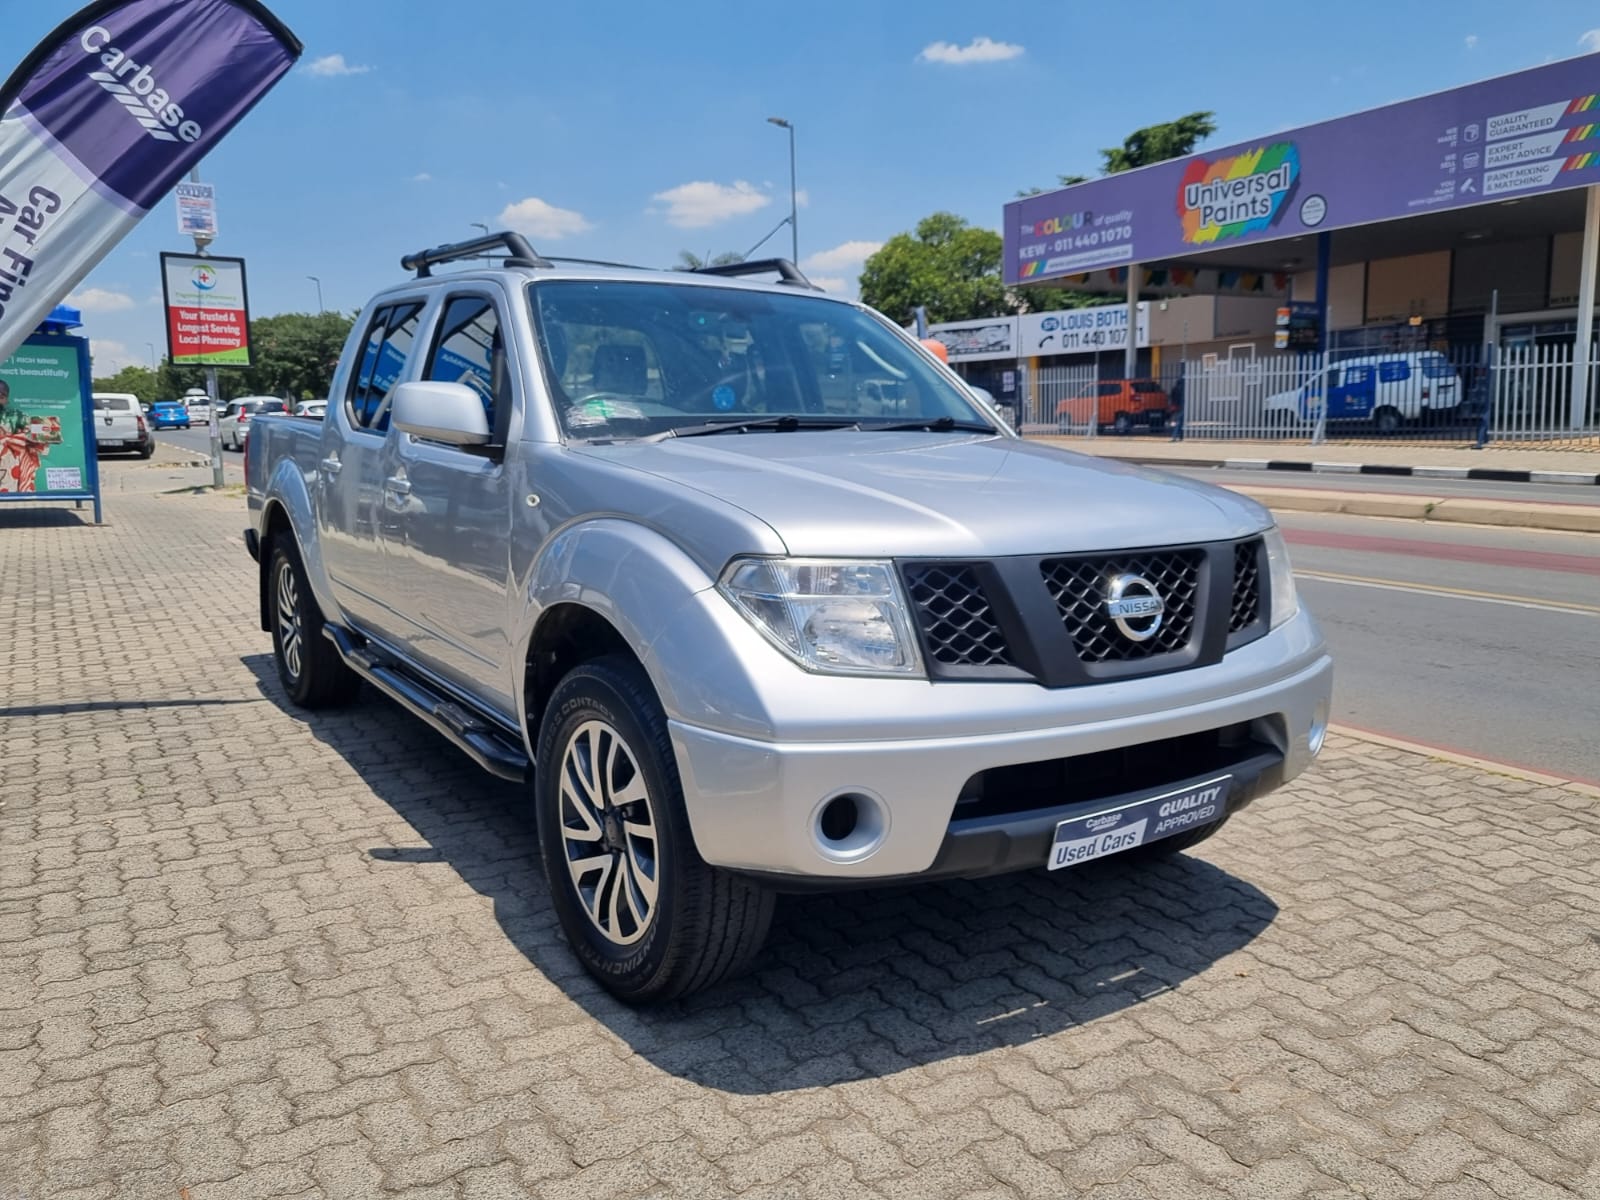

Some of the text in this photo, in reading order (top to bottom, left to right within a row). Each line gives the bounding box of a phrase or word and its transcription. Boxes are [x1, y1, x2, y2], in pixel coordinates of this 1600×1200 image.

[81, 26, 202, 143] Carbase
[1489, 113, 1529, 129] QUALITY
[1489, 117, 1553, 137] GUARANTEED
[1487, 145, 1552, 164] PAINT ADVICE
[1488, 142, 1525, 156] EXPERT
[1487, 165, 1550, 183] PAINT MIXING
[1487, 175, 1543, 192] & MATCHING
[1186, 164, 1289, 208] Universal
[13, 185, 62, 246] Car
[1202, 195, 1270, 226] Paints
[1034, 211, 1094, 237] COLOUR
[1094, 215, 1105, 226] of
[1105, 210, 1133, 225] quality
[1019, 243, 1047, 259] KEW
[1054, 238, 1073, 253] 011
[1074, 233, 1099, 248] 440
[1101, 225, 1132, 243] 1070
[0, 247, 35, 321] Fin
[179, 310, 237, 322] Your Trusted &
[1061, 312, 1093, 331] LOUIS
[1096, 309, 1129, 328] BOTH
[177, 322, 240, 336] Longest Serving
[178, 333, 240, 348] Local Pharmacy
[1062, 333, 1080, 348] 011
[1082, 331, 1106, 346] 440
[20, 367, 70, 379] beautifully
[1120, 600, 1161, 614] NISSA
[561, 697, 615, 722] CONTACT
[1158, 786, 1222, 817] QUALITY
[1085, 812, 1123, 829] Carbase
[1154, 804, 1216, 835] APPROVED
[1055, 830, 1137, 865] Used Cars
